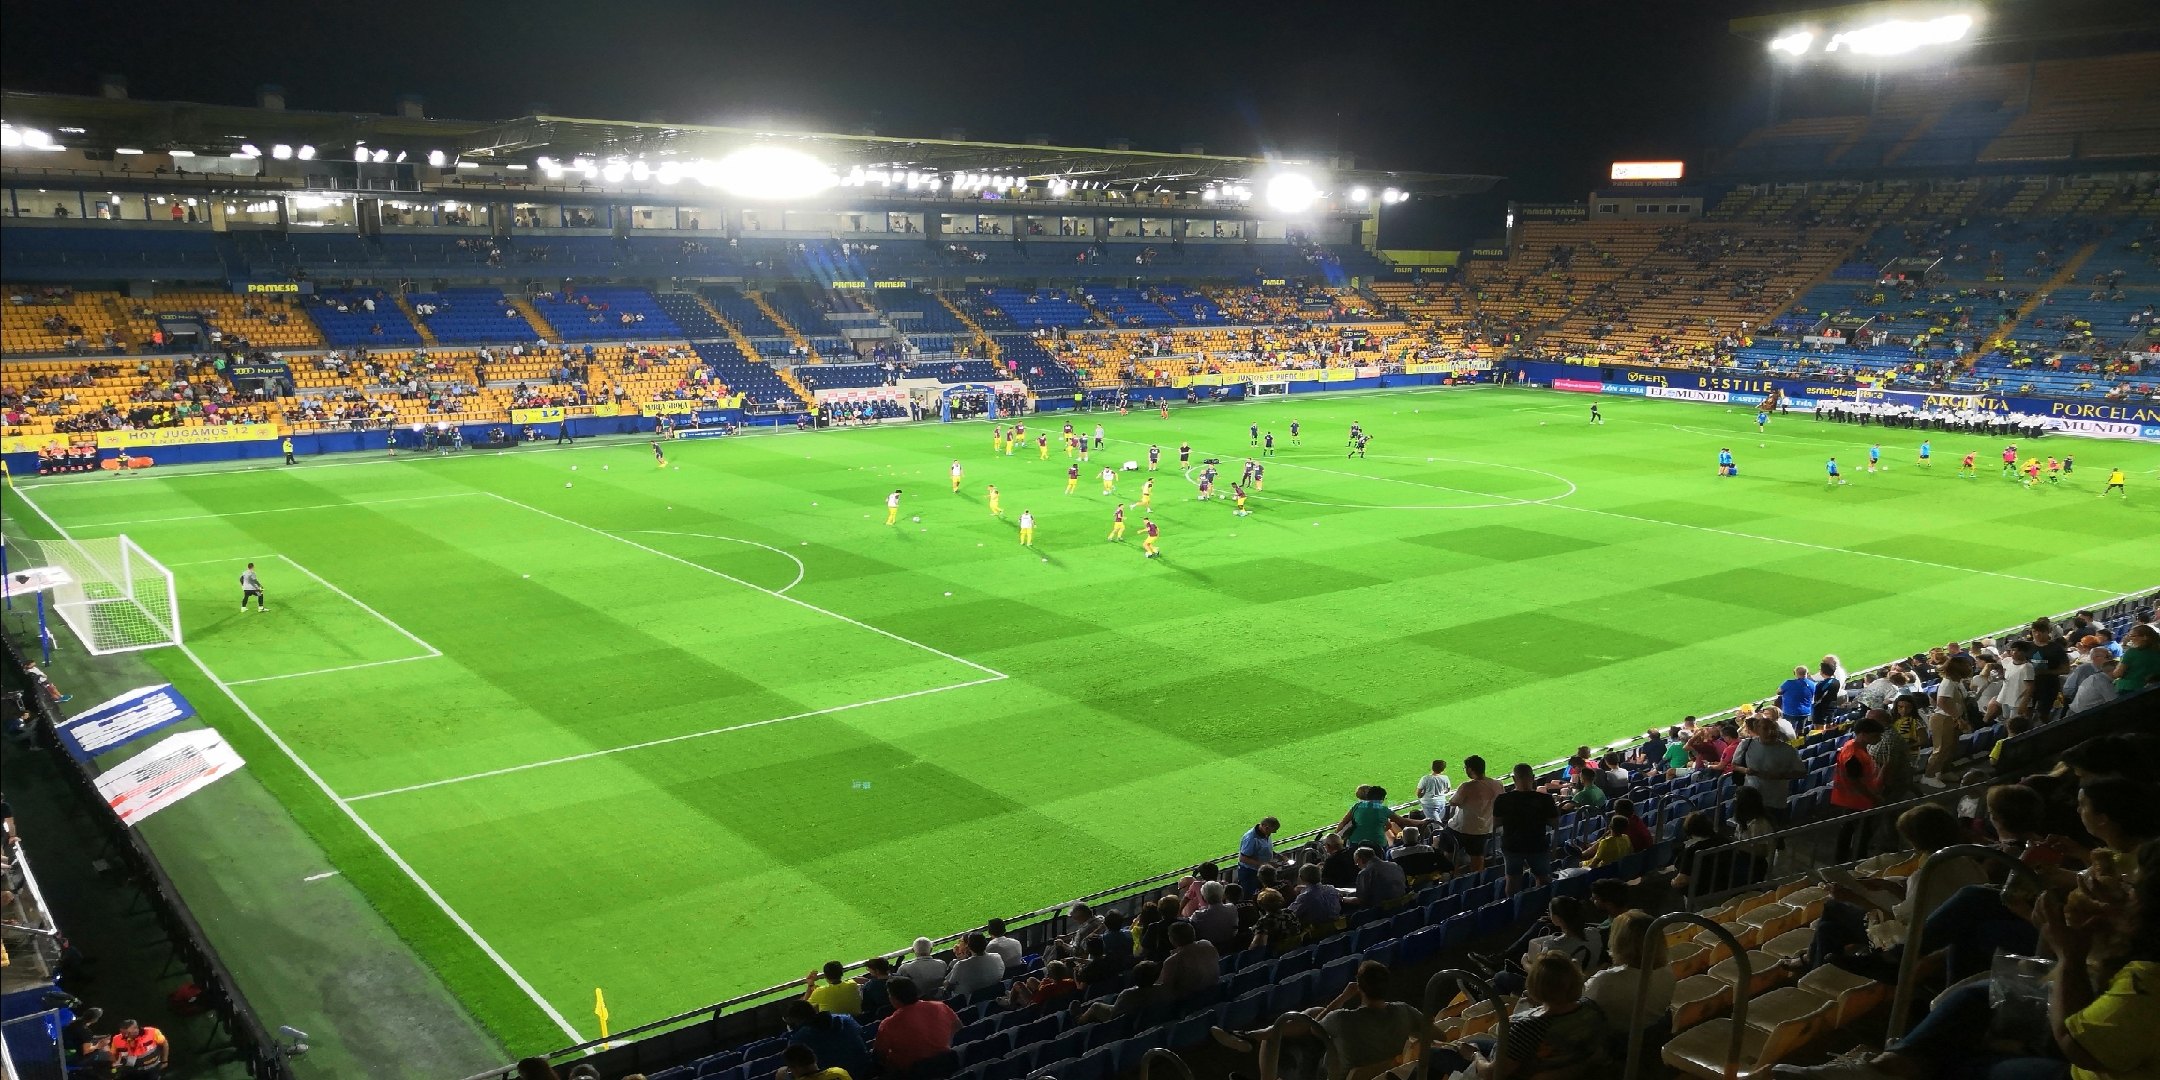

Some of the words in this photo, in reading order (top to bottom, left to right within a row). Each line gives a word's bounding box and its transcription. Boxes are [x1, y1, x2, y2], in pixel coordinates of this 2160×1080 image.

[248, 284, 299, 293] PAMESA
[832, 281, 866, 289] PAMESA
[874, 281, 906, 289] PAMESA
[1236, 374, 1263, 383] JUNTOS
[1698, 377, 1773, 393] BESTILE
[1674, 389, 1727, 402] MUNDO
[1805, 386, 1856, 399] esmalglass
[1926, 395, 2009, 412] ARGENTA
[128, 430, 157, 442] HOY
[162, 427, 229, 439] JUGAMOS
[234, 427, 249, 436] 12
[2062, 420, 2138, 436] MUNDO
